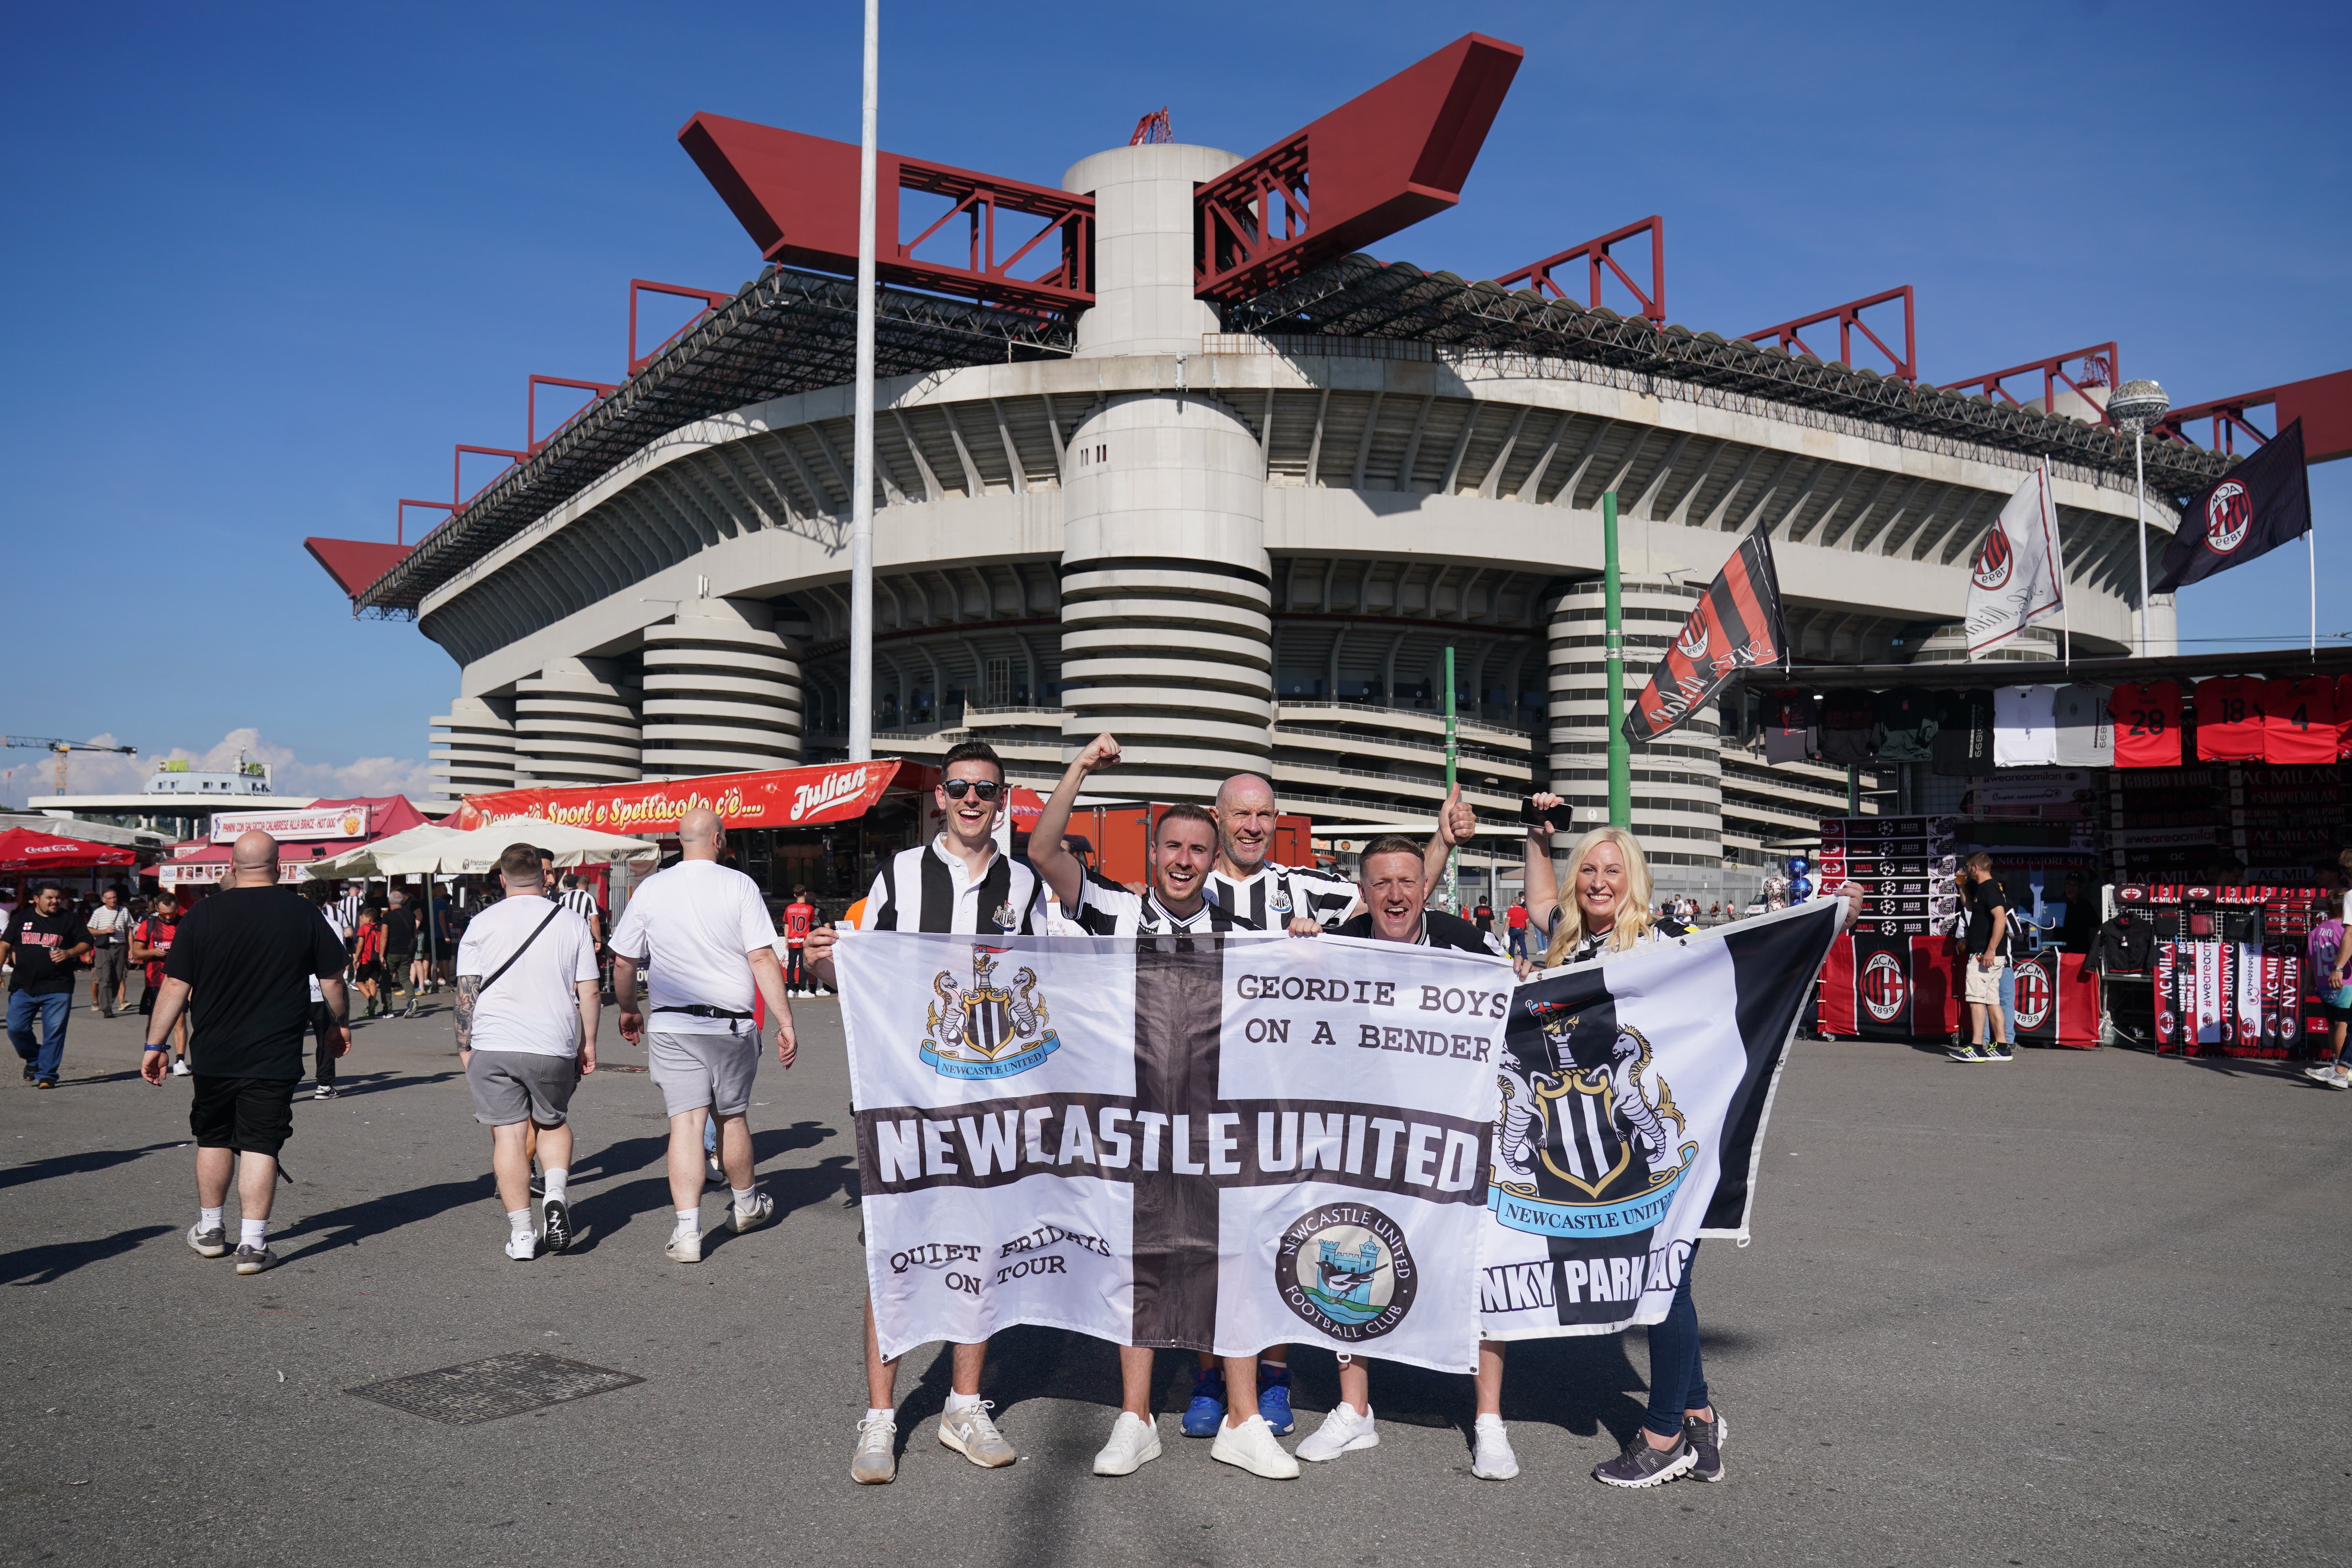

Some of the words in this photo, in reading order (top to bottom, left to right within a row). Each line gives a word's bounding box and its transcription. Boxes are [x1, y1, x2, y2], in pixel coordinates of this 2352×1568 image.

[2130, 708, 2165, 735] 28
[2220, 697, 2245, 724] 18
[2291, 702, 2310, 731] 4
[790, 766, 867, 821] Julian
[546, 799, 592, 825] Sport
[595, 804, 606, 824] e
[791, 916, 806, 932] 10
[2319, 927, 2334, 937] THEO
[1871, 956, 1896, 969] ACM
[2016, 965, 2043, 978] ACM
[2159, 981, 2172, 999] AC
[2222, 956, 2234, 998] AMORE
[2283, 956, 2297, 1007] MILAN
[1237, 974, 1396, 1007] GEORDIE
[1419, 985, 1508, 1019] BOYS
[1873, 1006, 1895, 1014] 1899
[2222, 1000, 2233, 1017] SEI
[2017, 1014, 2039, 1022] 1899
[1245, 1018, 1291, 1044] ON
[1312, 1021, 1336, 1045] A
[1358, 1024, 1491, 1063] BENDER
[941, 1063, 1003, 1075] NEWCASTLE
[1004, 1053, 1042, 1072] UNITED
[876, 1104, 1241, 1182] NEWCASTLE
[1258, 1111, 1479, 1193] UNITED
[1505, 1203, 1619, 1229] NEWCASTLE
[890, 1243, 981, 1274] QUIET
[1000, 1225, 1111, 1258] FRIDAYS
[1283, 1208, 1372, 1256] NEWCASTLE
[1374, 1218, 1410, 1279] UNITED
[945, 1271, 981, 1295] ON
[997, 1255, 1067, 1284] TOUR
[1481, 1260, 1555, 1313] NKY
[1285, 1284, 1362, 1338] FOOTBALL
[1365, 1305, 1402, 1333] CLUB
